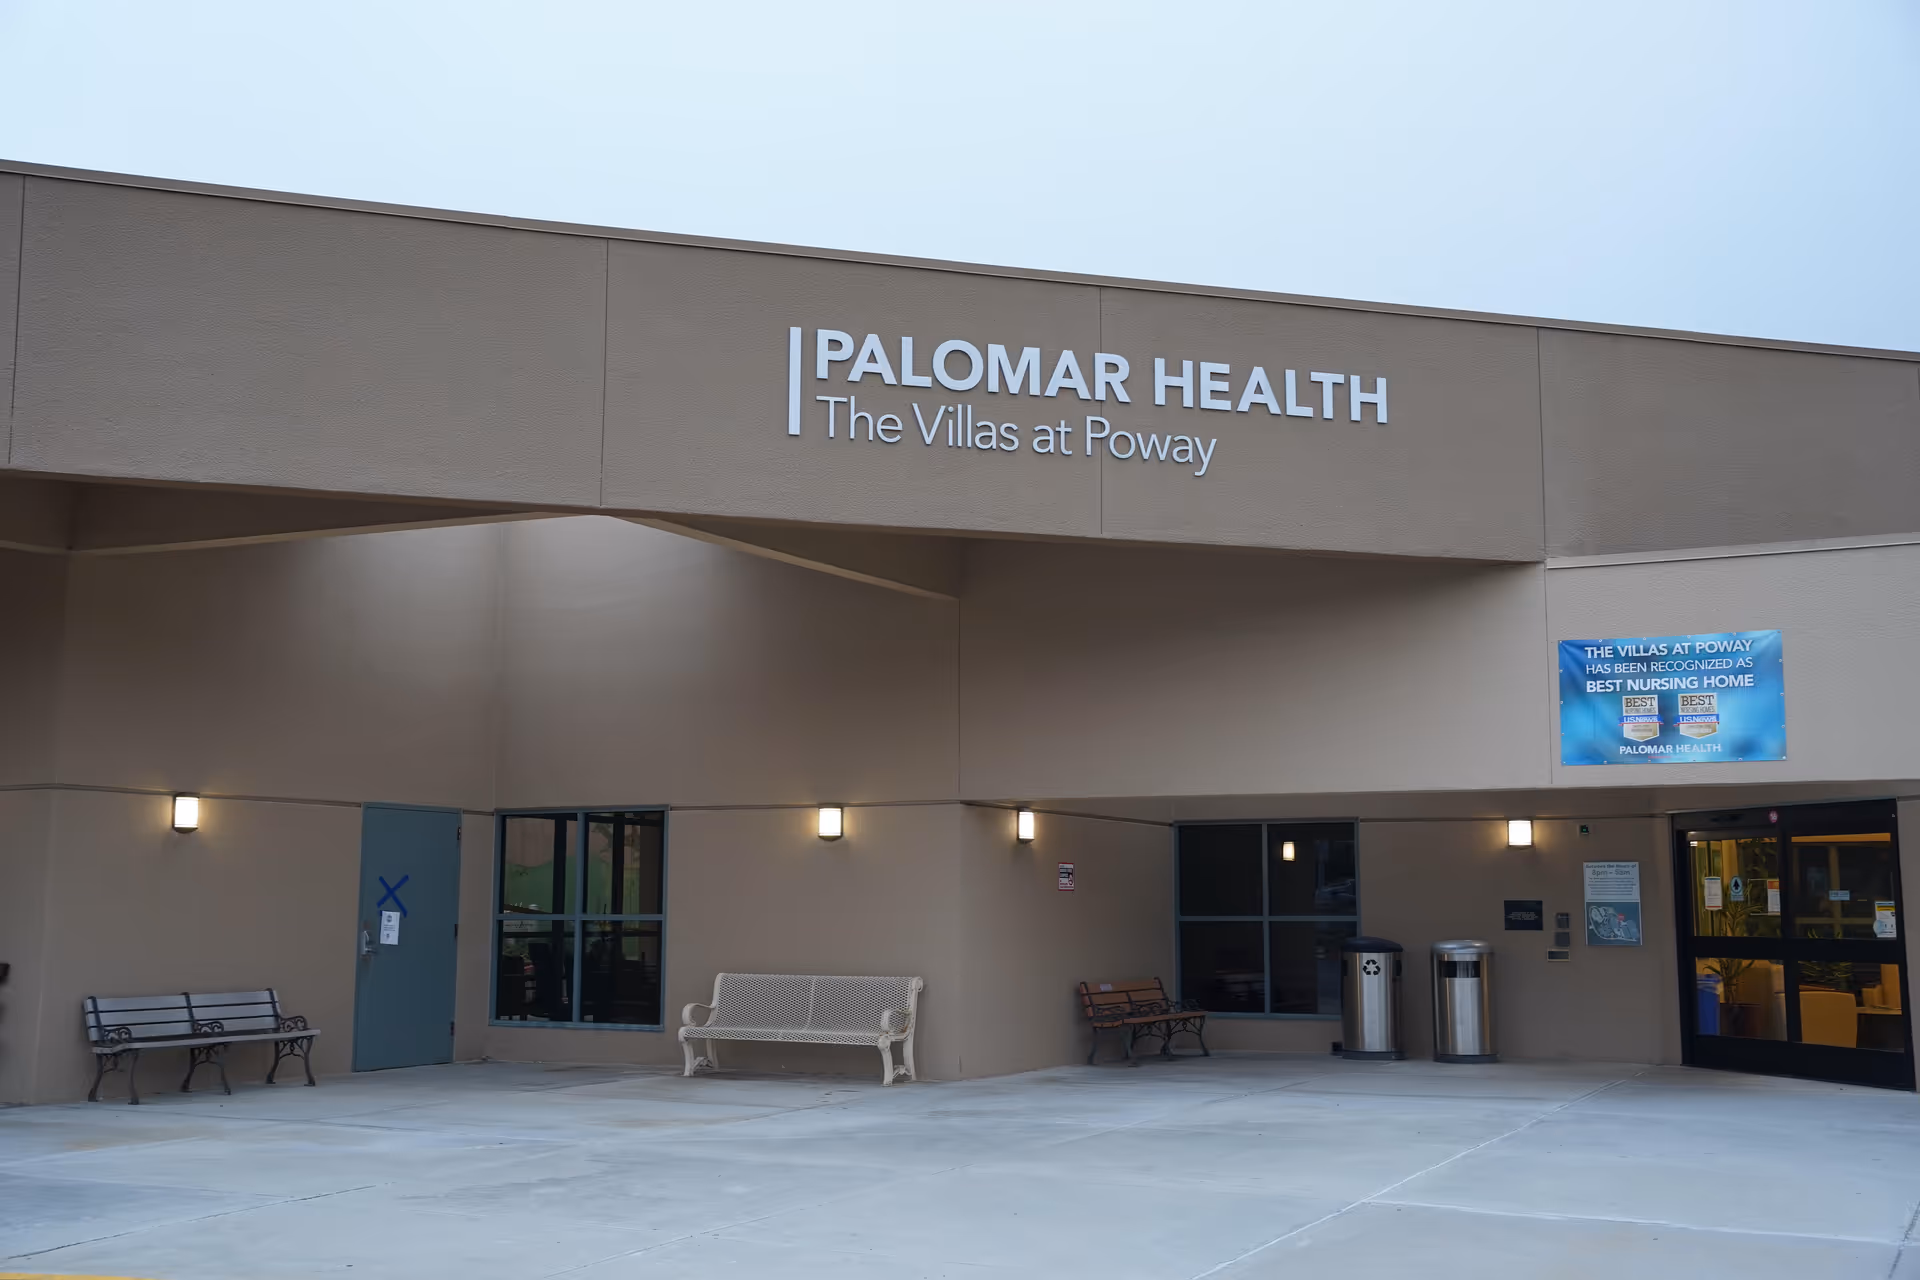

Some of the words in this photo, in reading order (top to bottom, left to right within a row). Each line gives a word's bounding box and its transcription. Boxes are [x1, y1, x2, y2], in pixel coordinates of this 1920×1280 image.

[816, 328, 1131, 404] PALOMAR
[1153, 357, 1389, 424] HEALTH
[816, 395, 903, 444] The
[912, 402, 1019, 452] Villas
[1032, 420, 1073, 456] at
[1085, 415, 1217, 476] Poway
[1584, 647, 1614, 659] THE
[1617, 644, 1668, 657] VILLAS
[1671, 642, 1691, 656] AT
[1695, 639, 1753, 654] POWAY
[1586, 663, 1611, 675] HAS
[1614, 662, 1647, 673] BEEN
[1650, 658, 1732, 673] RECOGNIZED
[1735, 657, 1753, 668] AS
[1586, 679, 1623, 693] BEST
[1626, 676, 1698, 692] NURSING
[1703, 674, 1754, 688] HOME
[1625, 697, 1655, 708] BEST
[1681, 695, 1714, 706] BEST
[1619, 744, 1673, 755] PALOMAR
[1676, 743, 1721, 753] HEALTH
